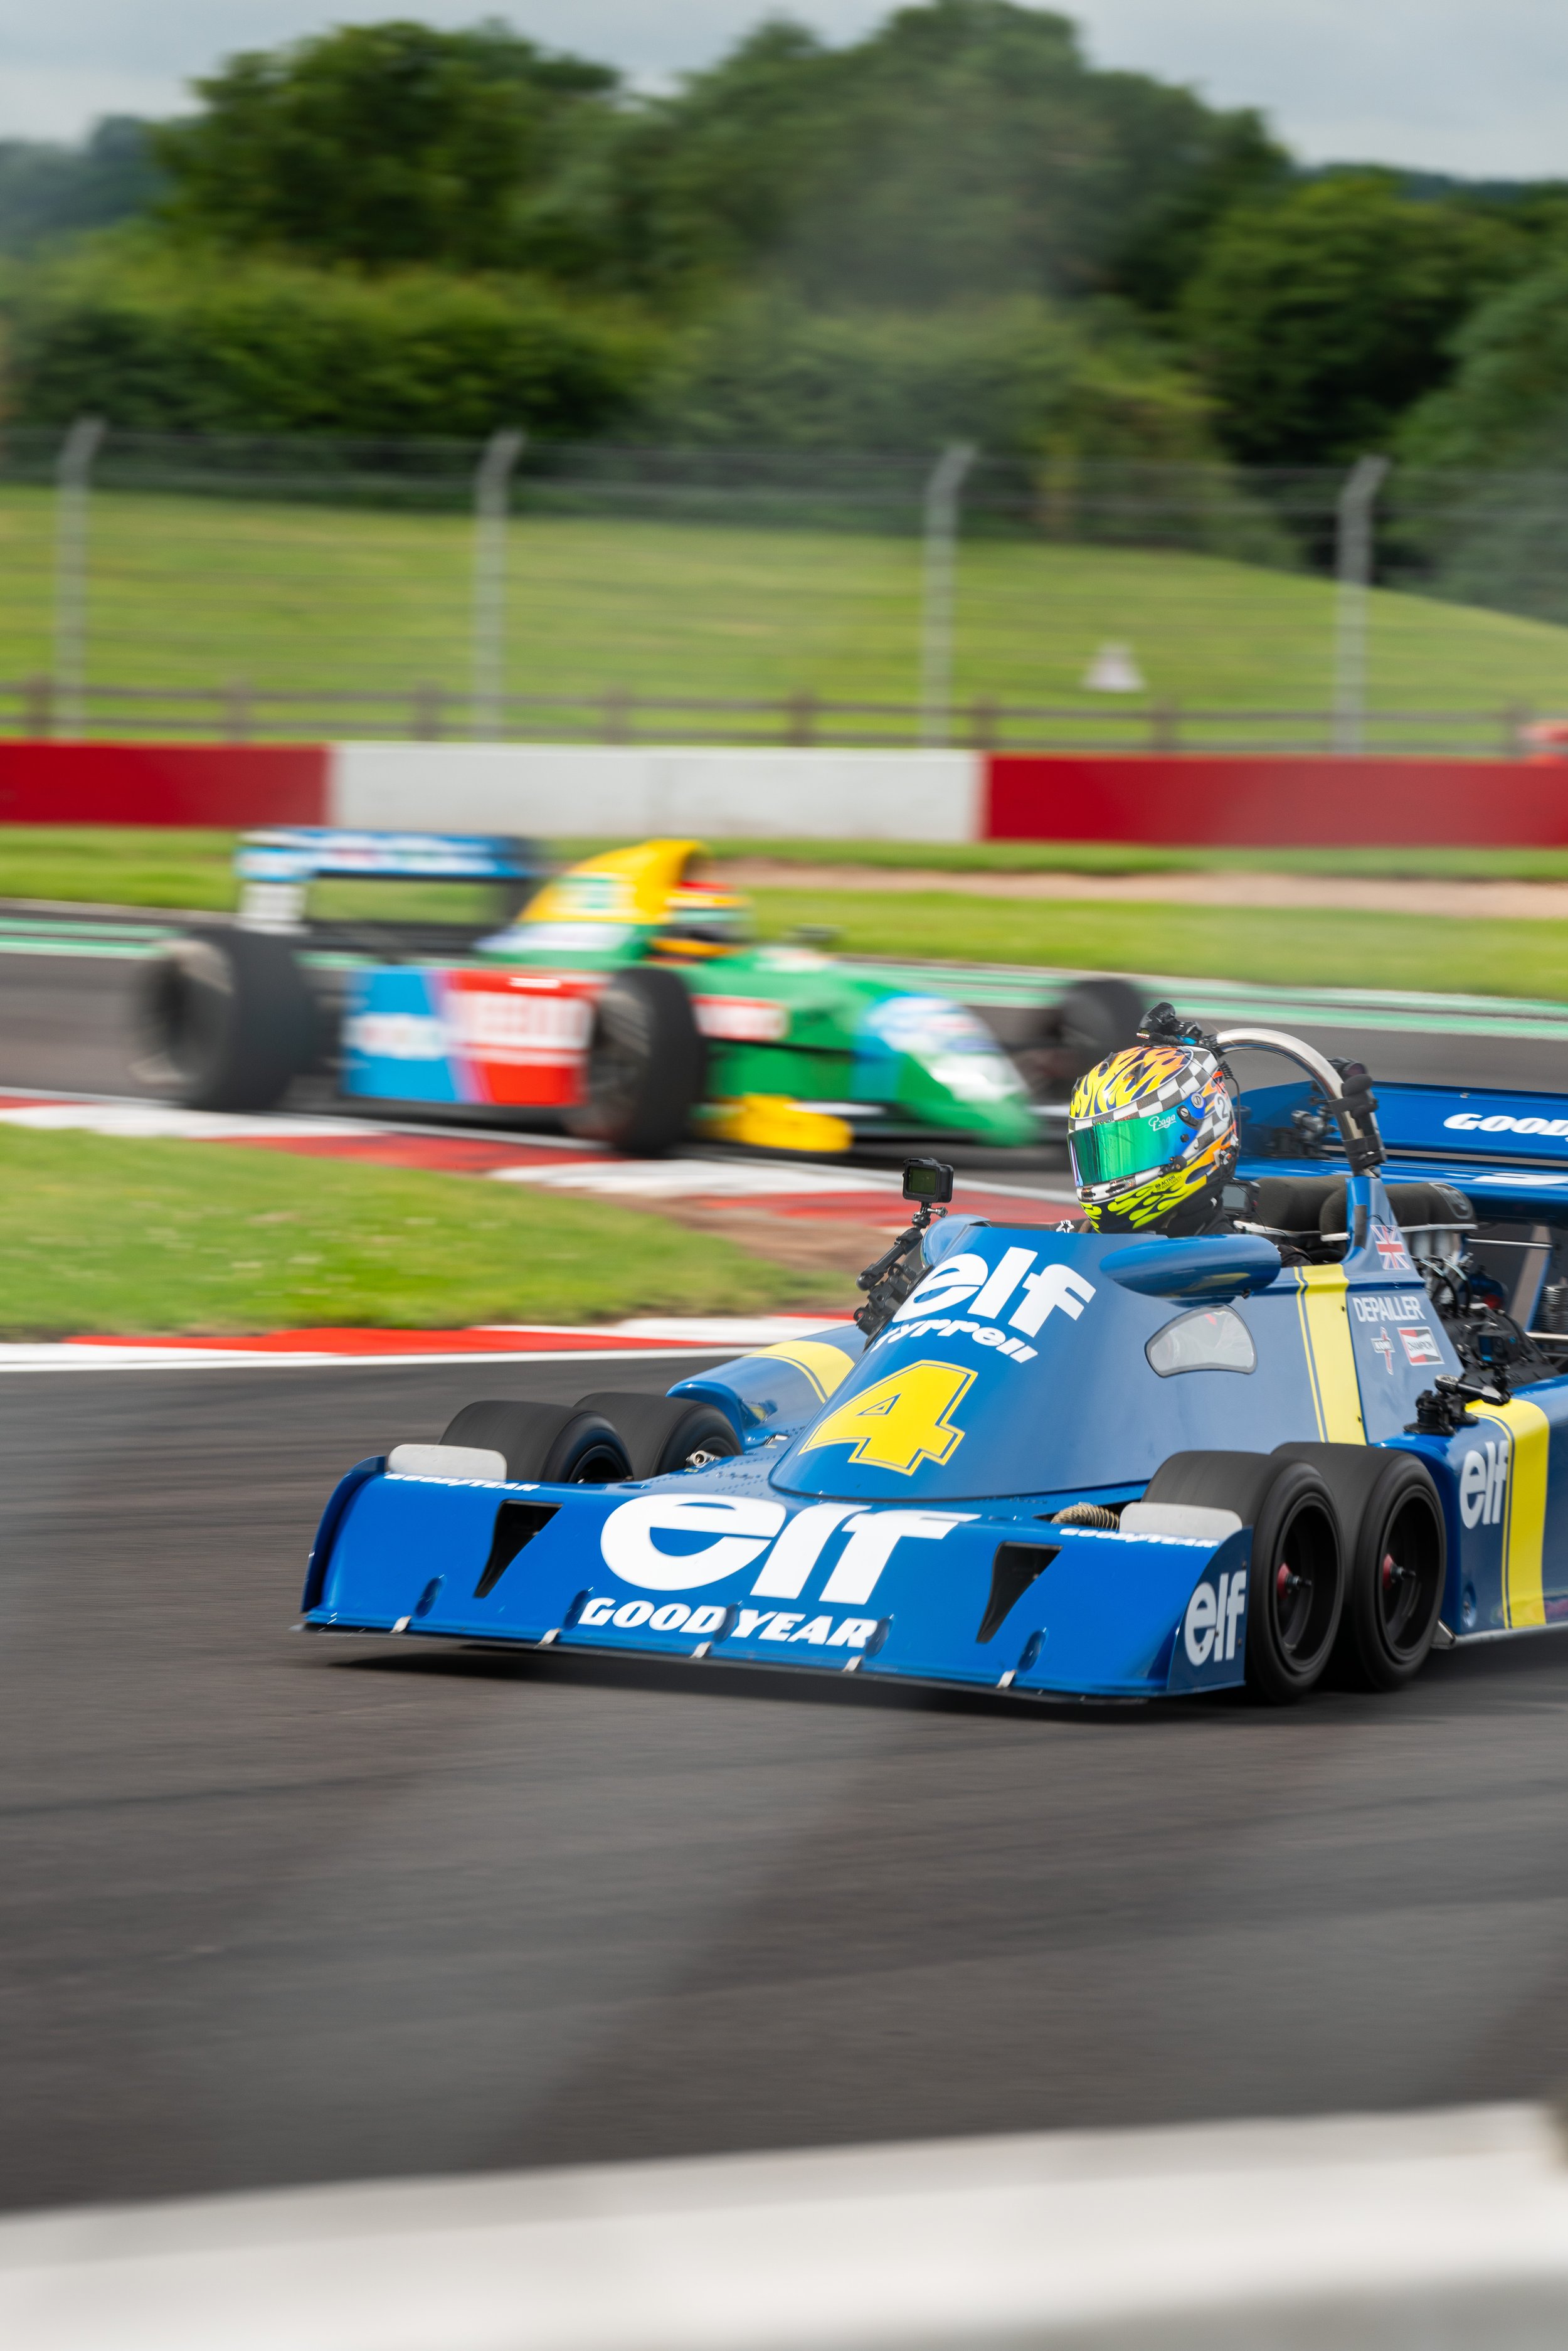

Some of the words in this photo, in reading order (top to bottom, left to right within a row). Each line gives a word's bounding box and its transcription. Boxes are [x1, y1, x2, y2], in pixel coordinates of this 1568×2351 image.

[1443, 1113, 1568, 1137] GOOD
[891, 1246, 1097, 1339] elf
[1352, 1295, 1427, 1323] DEPAILLER
[798, 1359, 978, 1477] 4
[1459, 1439, 1509, 1530] elf
[600, 1493, 981, 1605] elf
[1184, 1570, 1247, 1666] elf
